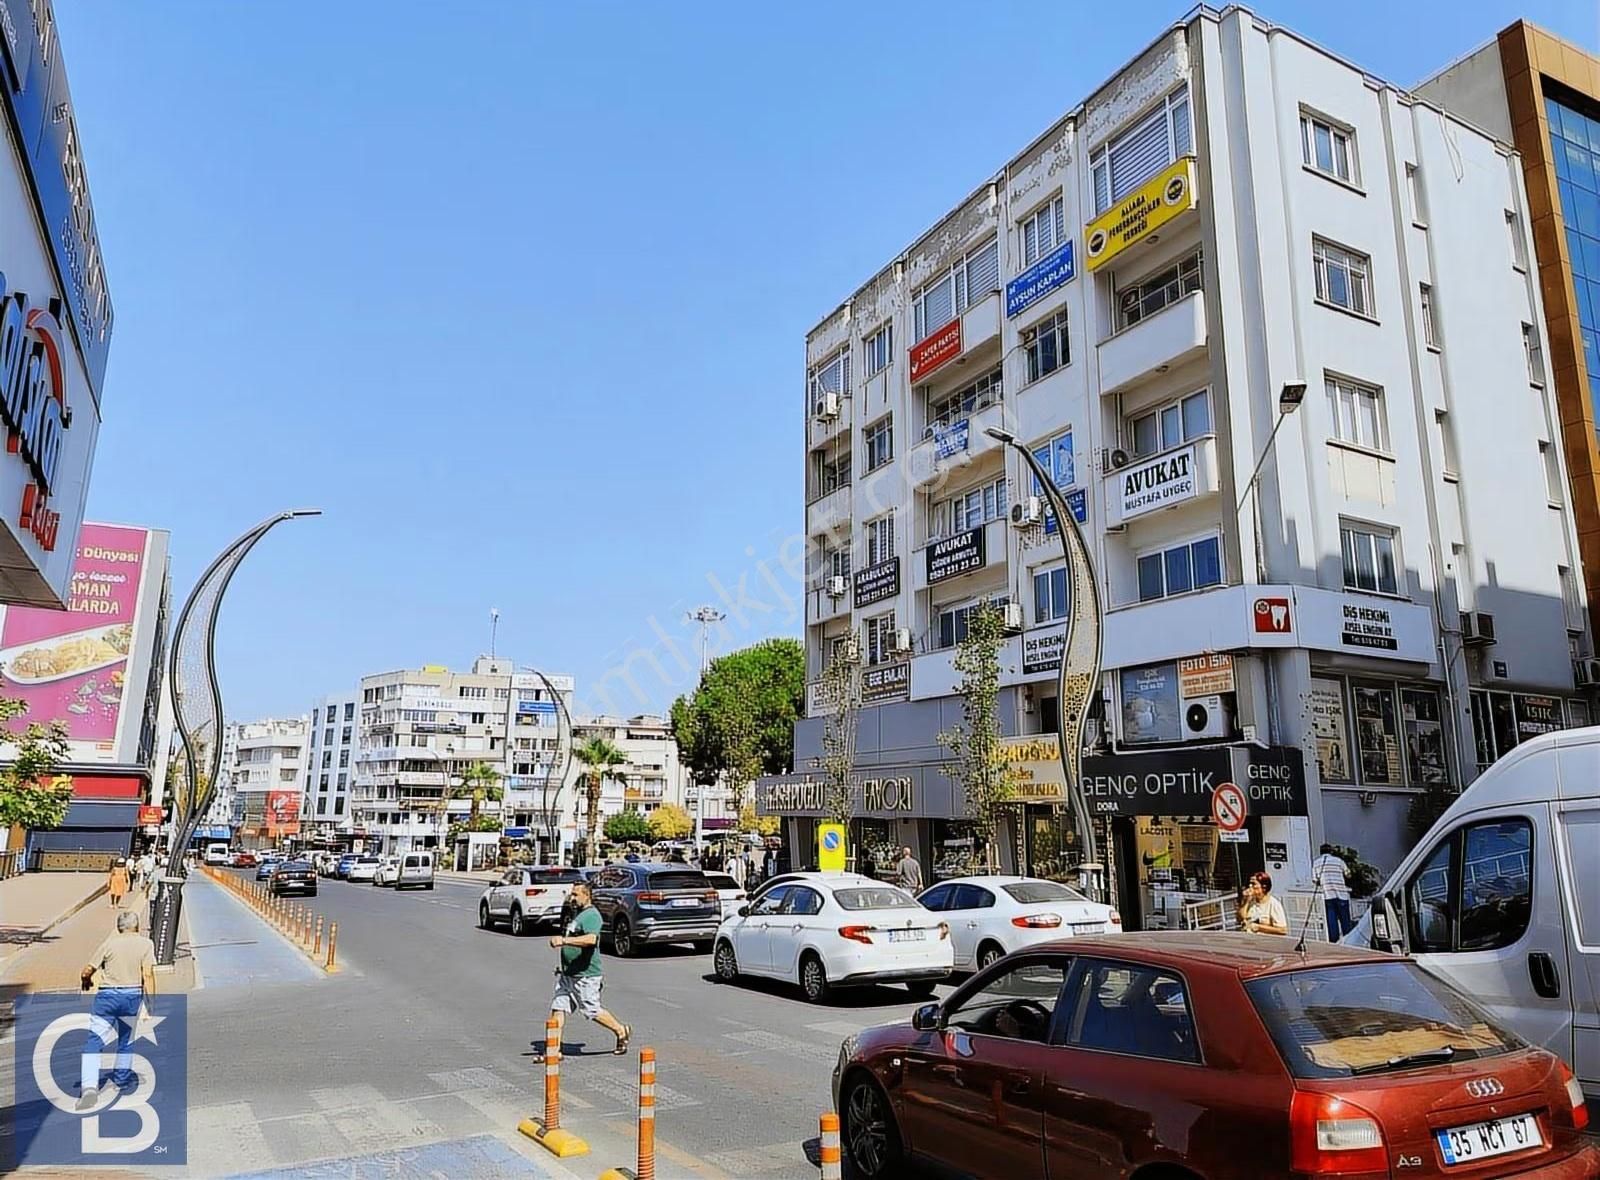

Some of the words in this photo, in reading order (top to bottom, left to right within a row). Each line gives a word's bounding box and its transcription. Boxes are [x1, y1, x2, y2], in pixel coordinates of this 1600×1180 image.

[1124, 453, 1190, 497] AVUKAT
[1125, 491, 1161, 511] MUSTAFA
[935, 532, 974, 557] AVUKAT
[83, 547, 139, 563] Dünyası
[70, 581, 111, 597] AMAN
[1343, 604, 1358, 621] DİŞ
[1181, 656, 1206, 671] FOTO
[1247, 764, 1291, 783] GENÇ
[1081, 775, 1137, 799] GENÇ
[1144, 767, 1216, 796] OPTİK
[863, 777, 913, 812] FAVORİ
[1096, 801, 1119, 812] DORA
[1140, 826, 1173, 837] LACOSTE
[1450, 1130, 1472, 1157] 35
[1511, 1117, 1530, 1144] 87
[1396, 1153, 1422, 1168] A3
